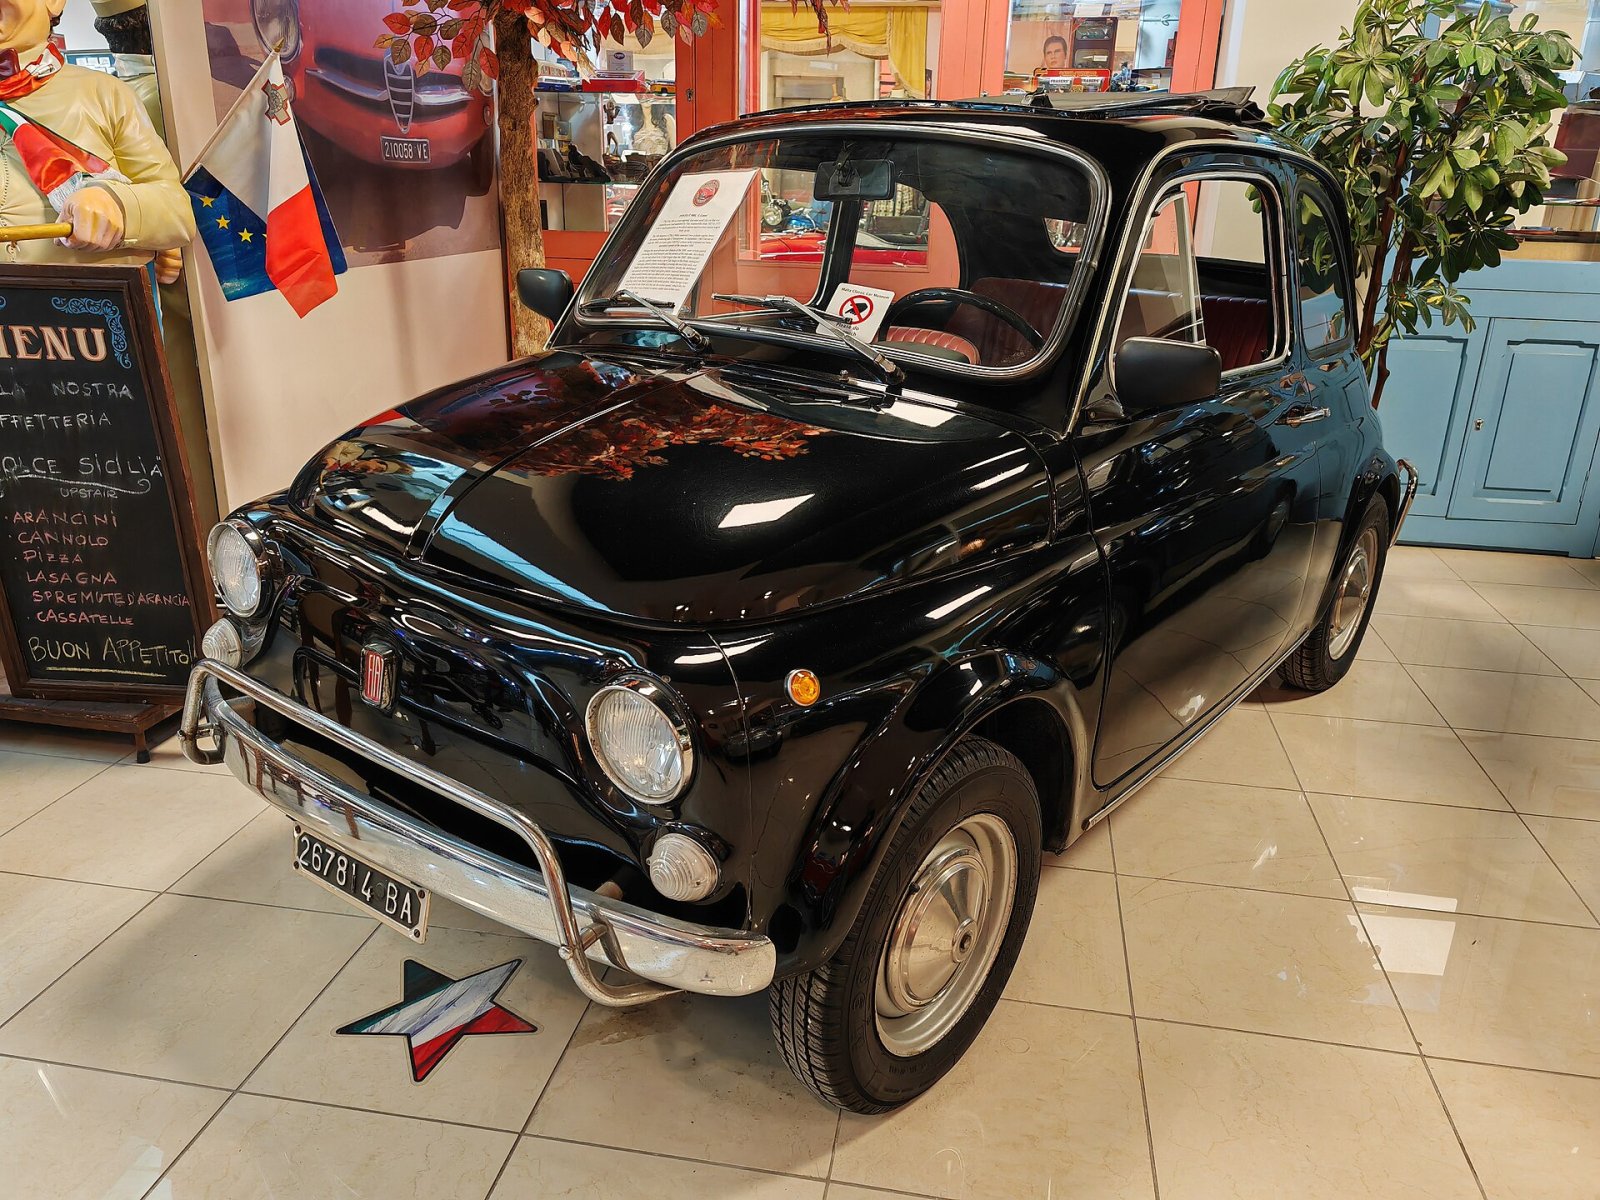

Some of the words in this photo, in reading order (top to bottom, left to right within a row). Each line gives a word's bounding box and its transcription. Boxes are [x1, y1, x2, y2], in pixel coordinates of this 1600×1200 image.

[384, 141, 414, 159] 210058
[416, 143, 428, 159] VE
[51, 381, 134, 400] NOSTRA
[60, 487, 118, 499] UPSTAIR
[13, 509, 118, 527] ARANCINI
[17, 530, 109, 547] CANNOLO
[23, 547, 84, 564] PIZZA
[27, 571, 118, 585] LASAGNA
[36, 609, 135, 626] CASSATELLE
[28, 636, 91, 663] BUON
[299, 836, 372, 902] 267814
[384, 881, 412, 924] BA
